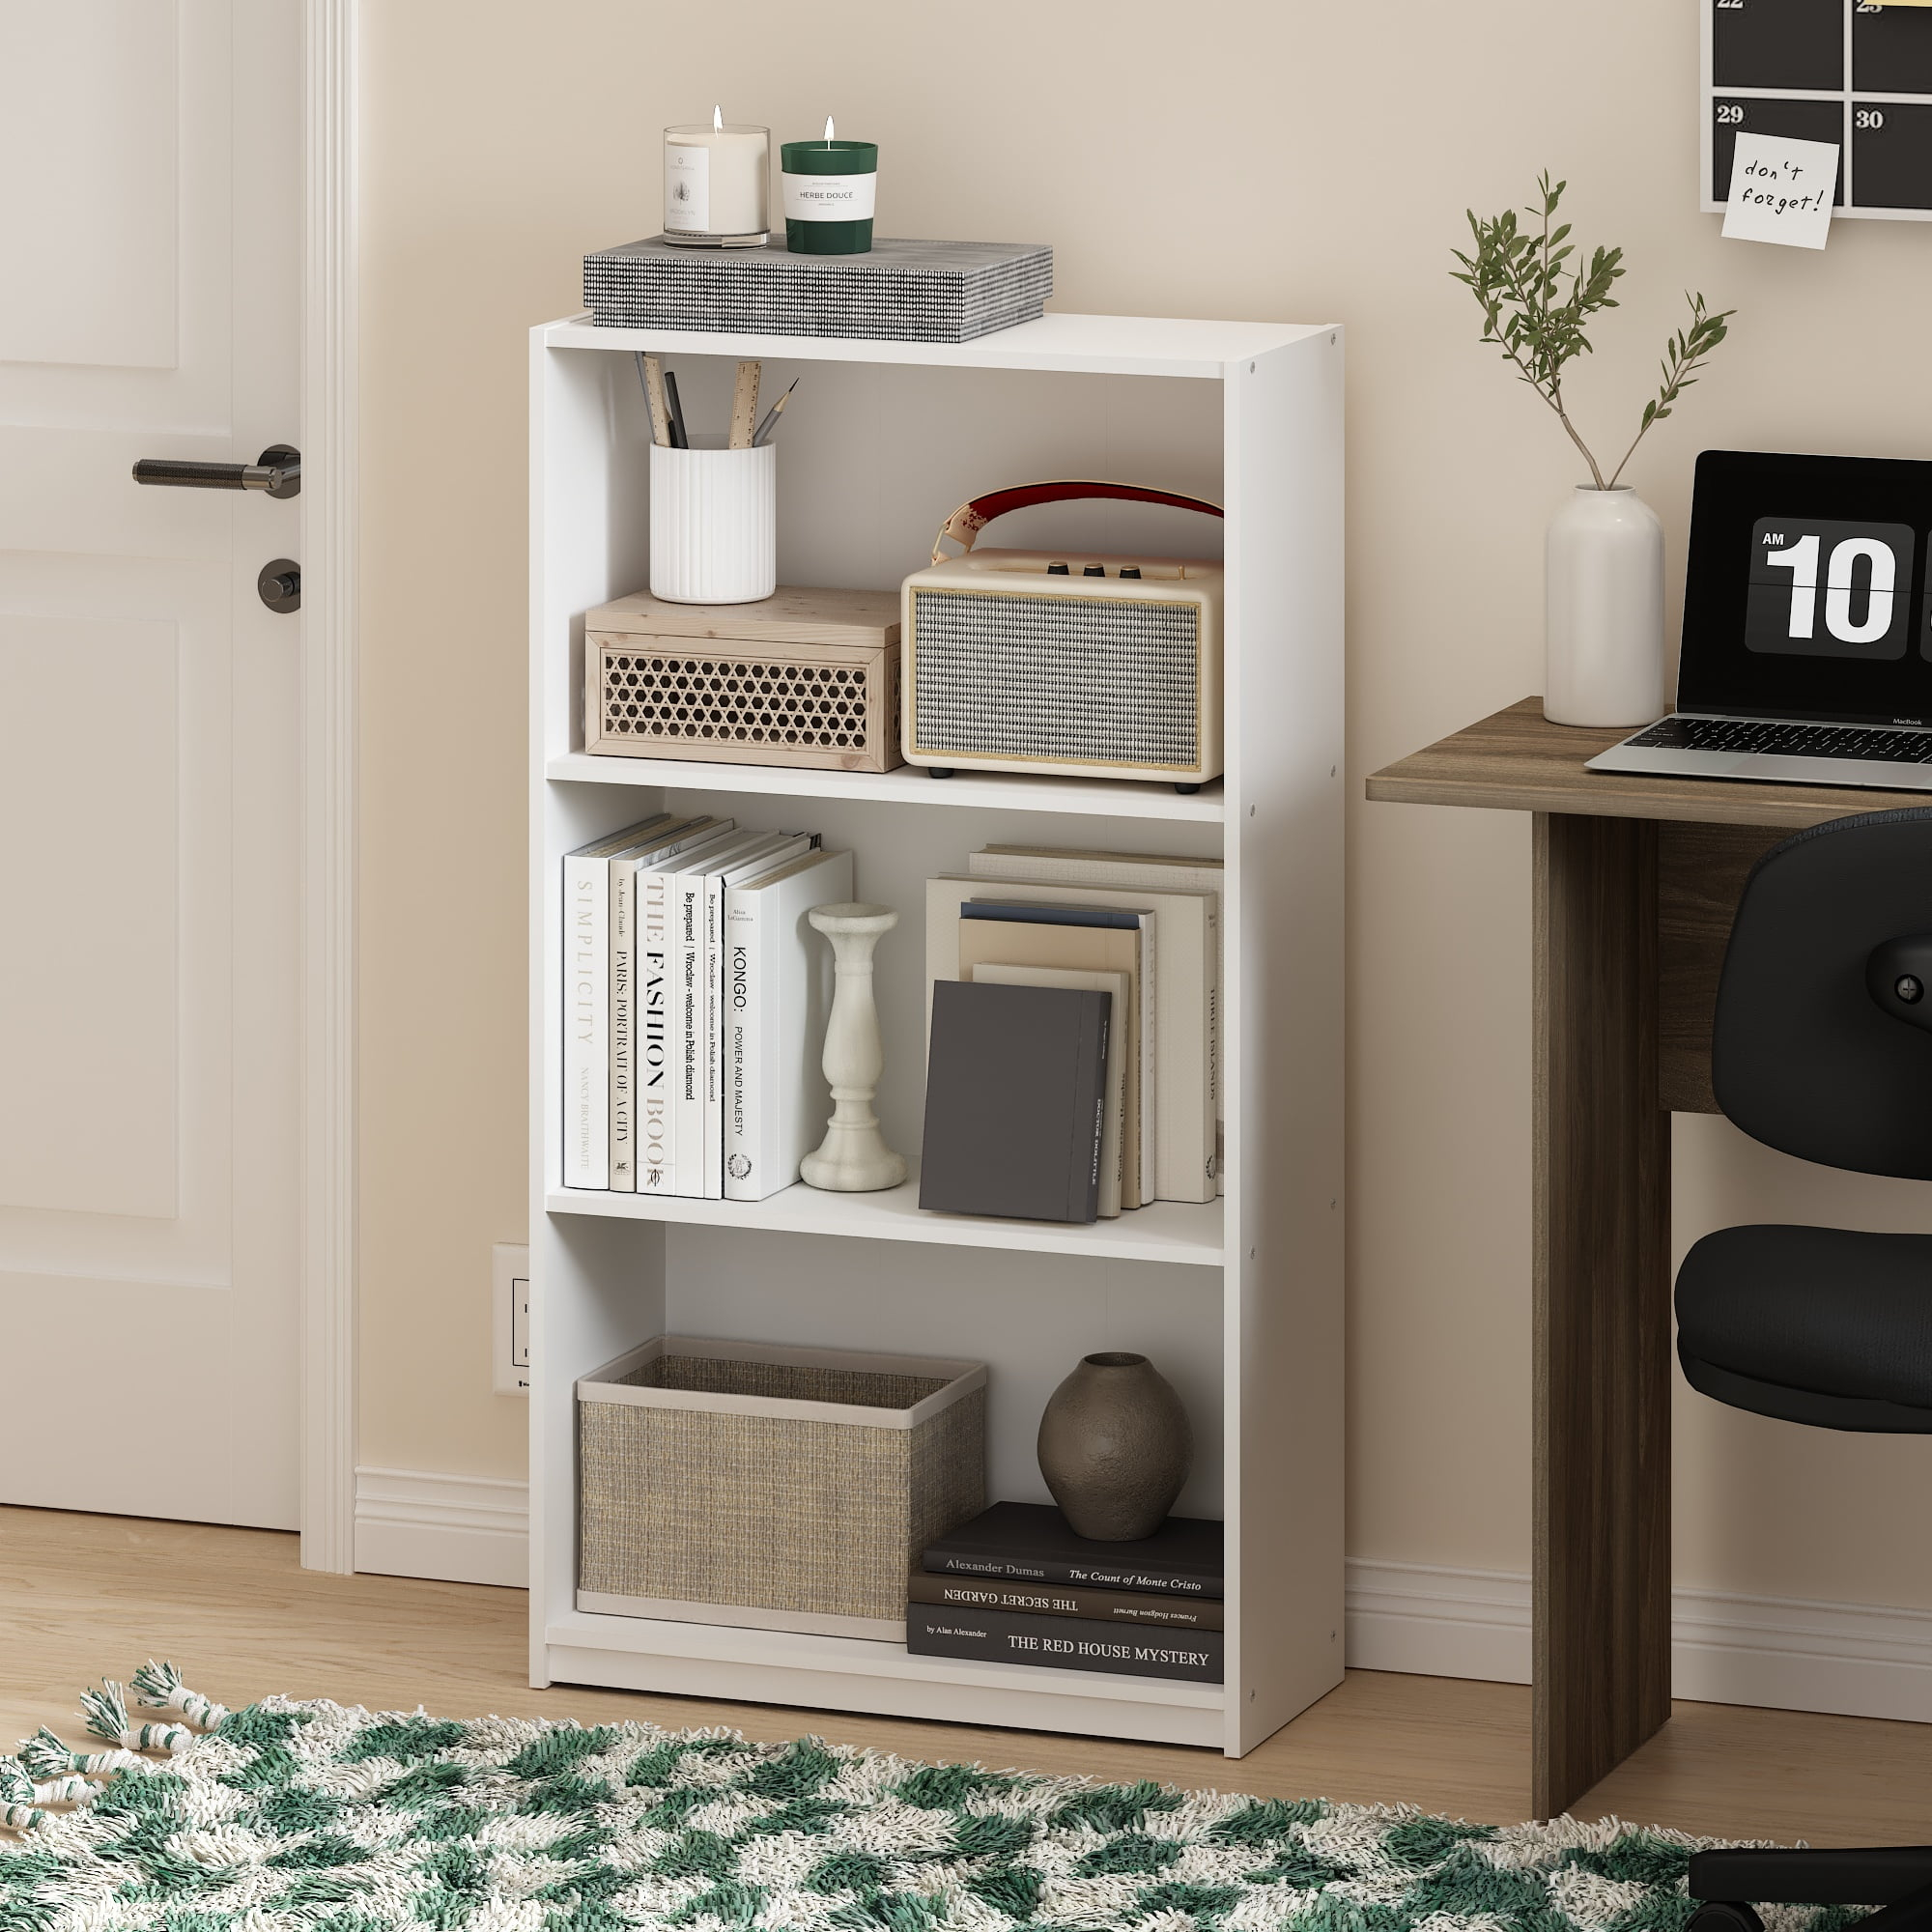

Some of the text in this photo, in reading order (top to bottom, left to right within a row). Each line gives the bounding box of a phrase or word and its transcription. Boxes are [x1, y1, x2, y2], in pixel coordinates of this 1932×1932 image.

[1717, 104, 1744, 124] 29
[1856, 109, 1884, 128] 30
[1745, 159, 1804, 181] don't
[1742, 187, 1824, 214] forget!
[1762, 532, 1784, 546] AM
[1767, 535, 1896, 644] 10
[616, 878, 625, 887] by
[646, 876, 665, 942] THE
[685, 893, 695, 903] Be
[709, 894, 716, 904] Be
[683, 903, 695, 942] prepared
[577, 880, 593, 1044] SIMPLICITY
[646, 951, 665, 1091] FASHION
[685, 992, 695, 1030] welcome
[709, 1032, 716, 1040] in
[733, 946, 747, 1136] KONGO: POWER AND MAJESTY
[616, 951, 628, 1145] PARIS: PORTRAIT OF A CITY
[685, 1039, 695, 1063] Polish
[581, 1066, 589, 1101] NANCY
[685, 1064, 695, 1100] diamond
[946, 1558, 1044, 1577] Alexander Dumas
[1068, 1569, 1202, 1591] The Count of Monte Cristo
[944, 1588, 1079, 1611] THE SECRET GARDEN
[1113, 1607, 1198, 1622] Frances Hodgson Burnett
[926, 1625, 987, 1637] by Alan Alexander
[1008, 1634, 1209, 1666] THE RED HOUSE MYSTERY
